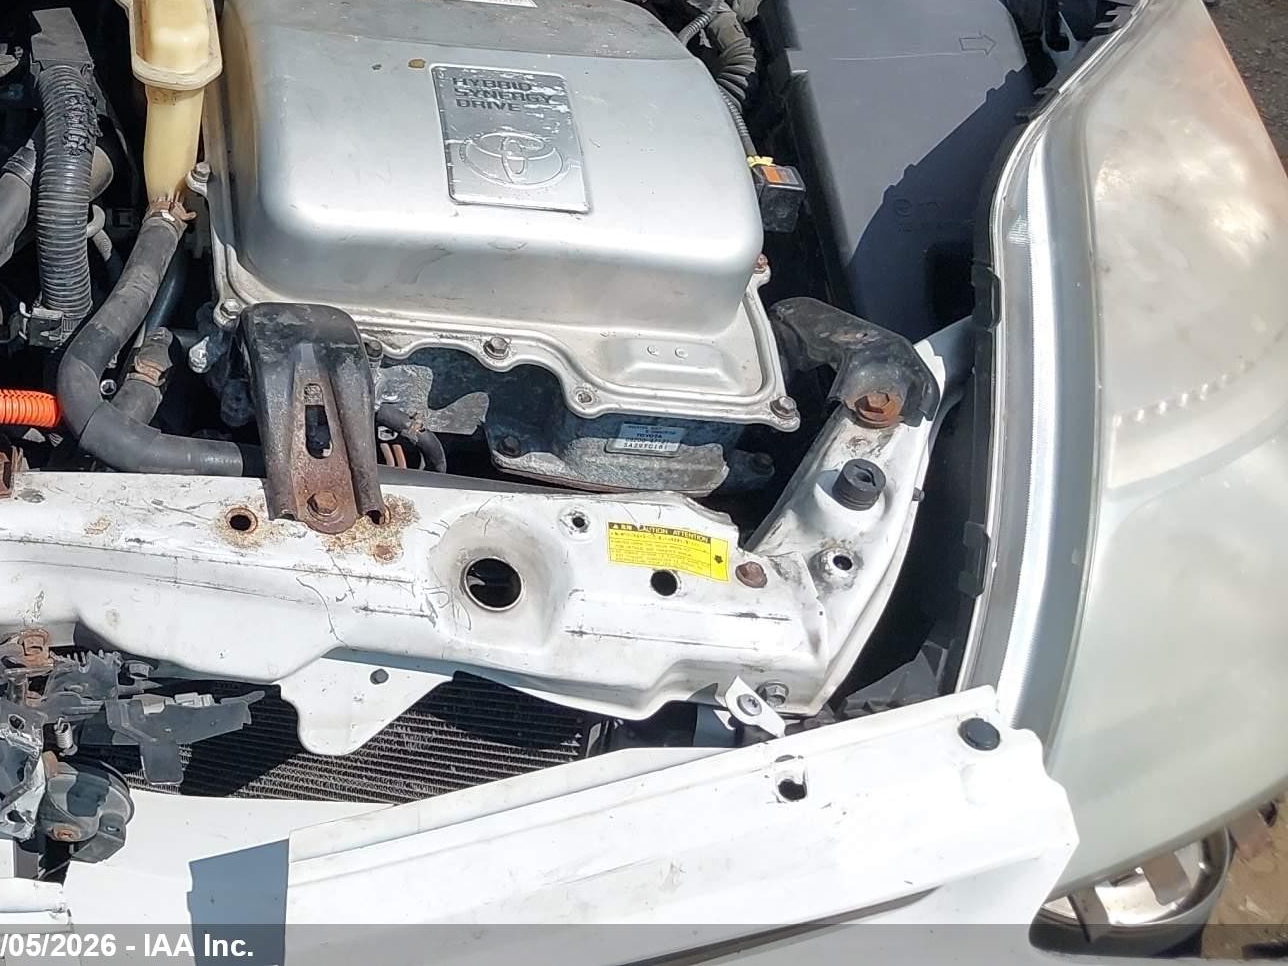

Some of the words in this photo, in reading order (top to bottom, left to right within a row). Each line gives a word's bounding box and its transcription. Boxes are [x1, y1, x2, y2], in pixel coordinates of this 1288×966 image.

[454, 88, 553, 104] SYNERGY
[456, 99, 522, 112] DRIVE
[638, 524, 669, 535] CAUTION
[672, 530, 709, 544] ATTENTION
